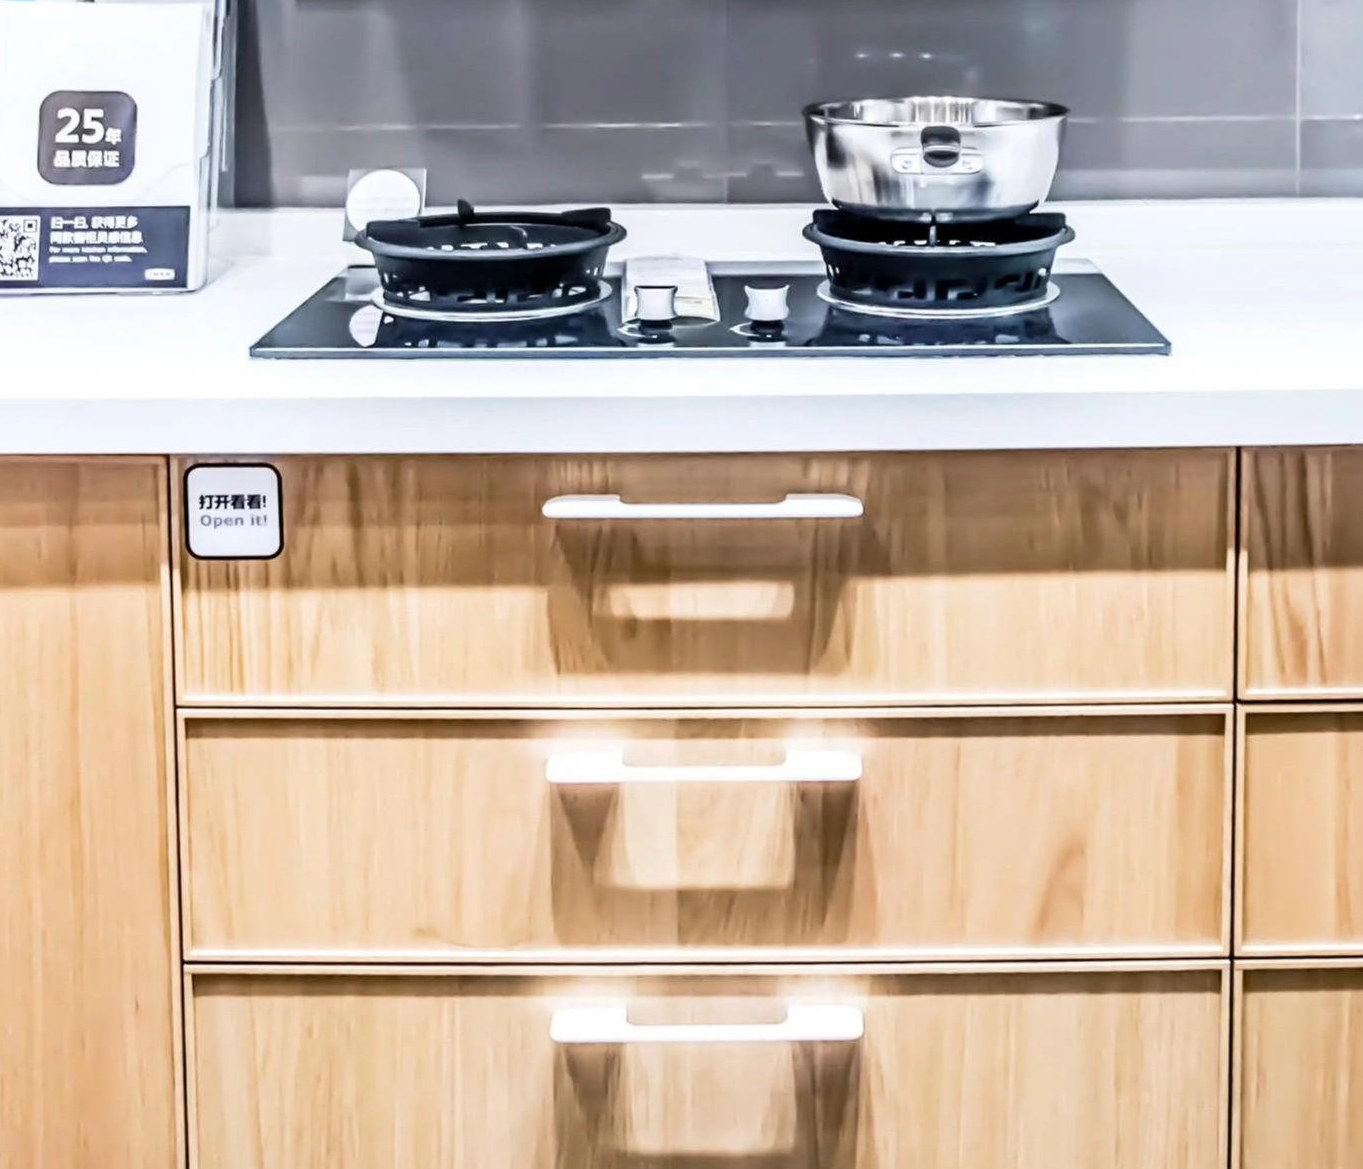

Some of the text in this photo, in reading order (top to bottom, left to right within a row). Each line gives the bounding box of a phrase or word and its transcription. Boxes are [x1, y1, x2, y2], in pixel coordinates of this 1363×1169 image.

[54, 150, 120, 167] 品质保证
[199, 494, 266, 509] 打开看看!
[200, 515, 267, 528] Open it!
